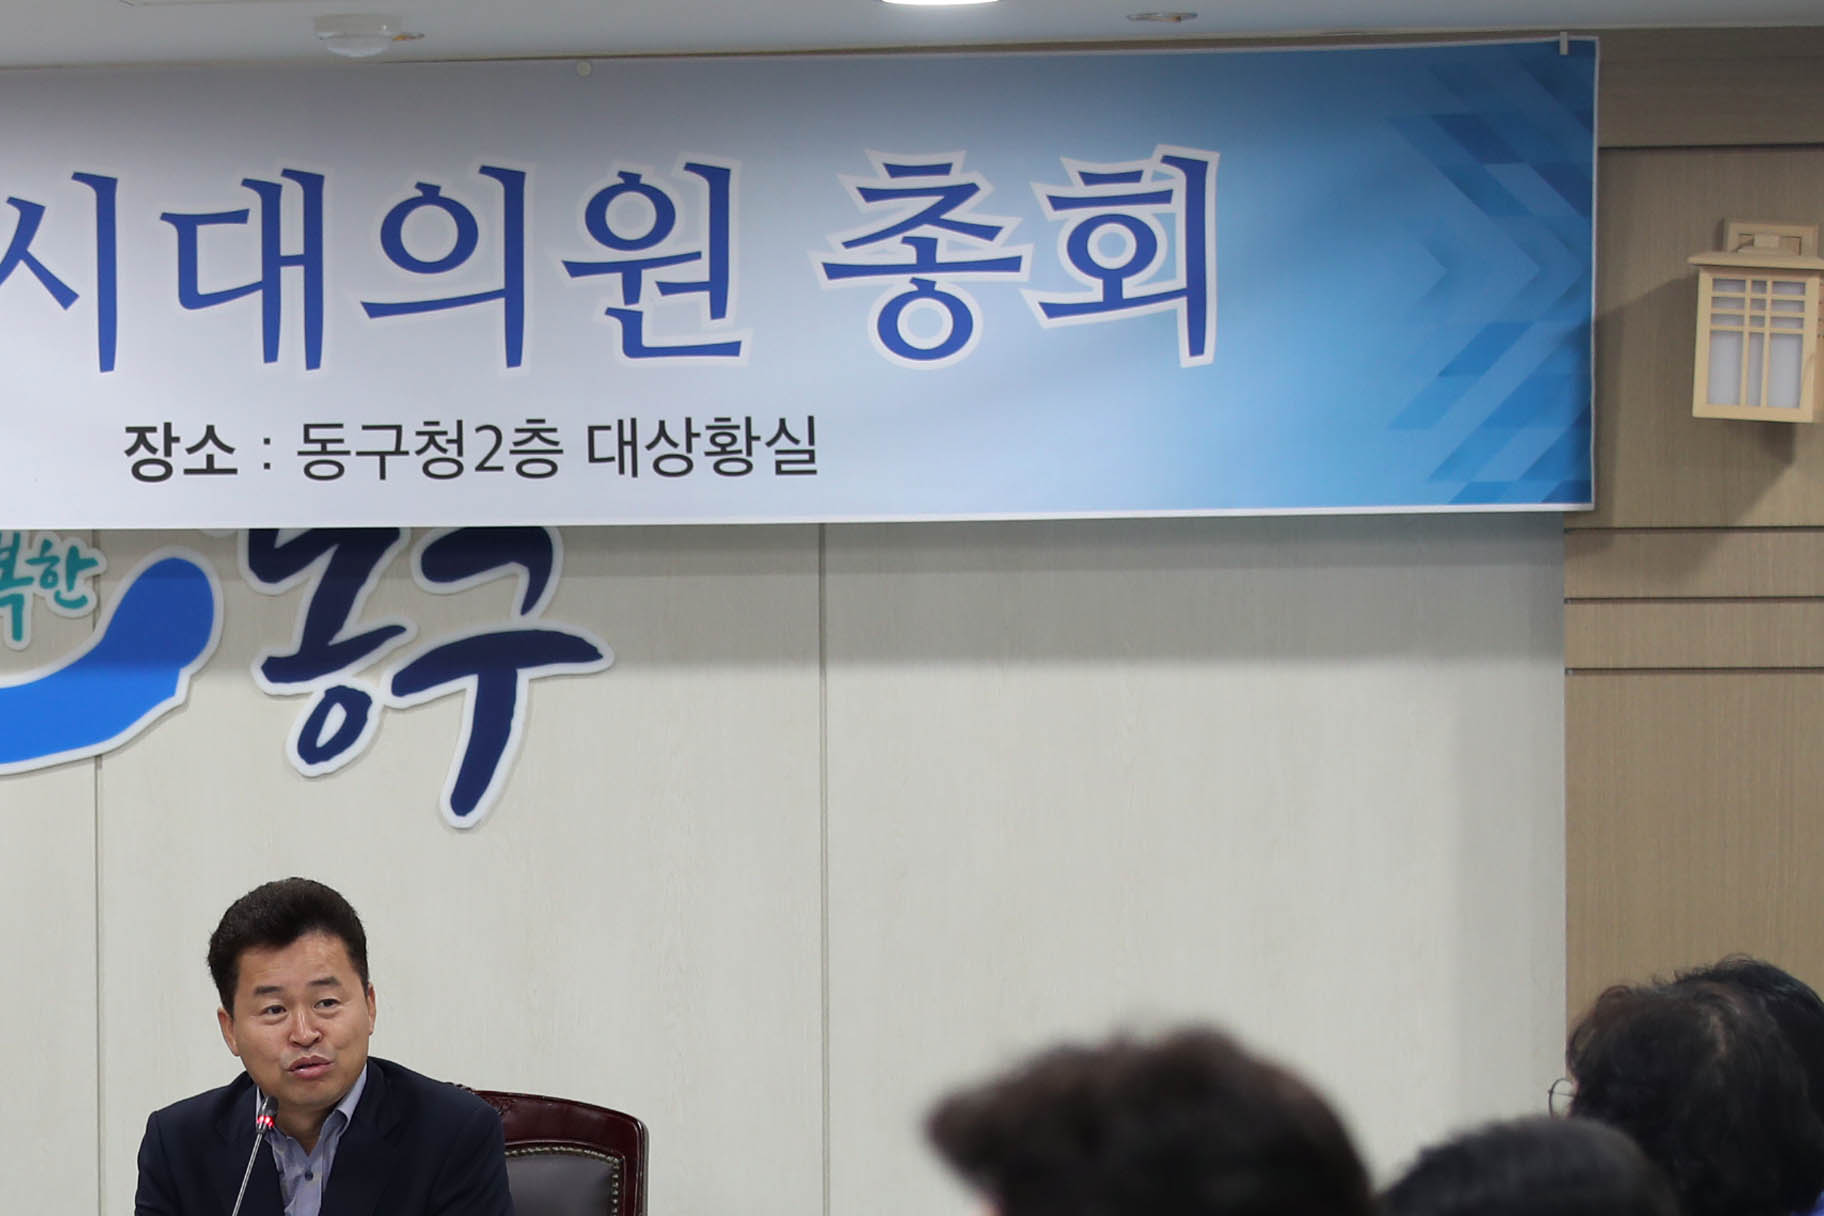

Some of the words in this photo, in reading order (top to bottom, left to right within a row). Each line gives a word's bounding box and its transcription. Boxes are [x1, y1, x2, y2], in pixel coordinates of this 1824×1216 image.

[821, 153, 1210, 360] 총회
[123, 421, 239, 484] 장소
[296, 417, 565, 482] 동구청2층
[586, 414, 819, 479] 대상황실
